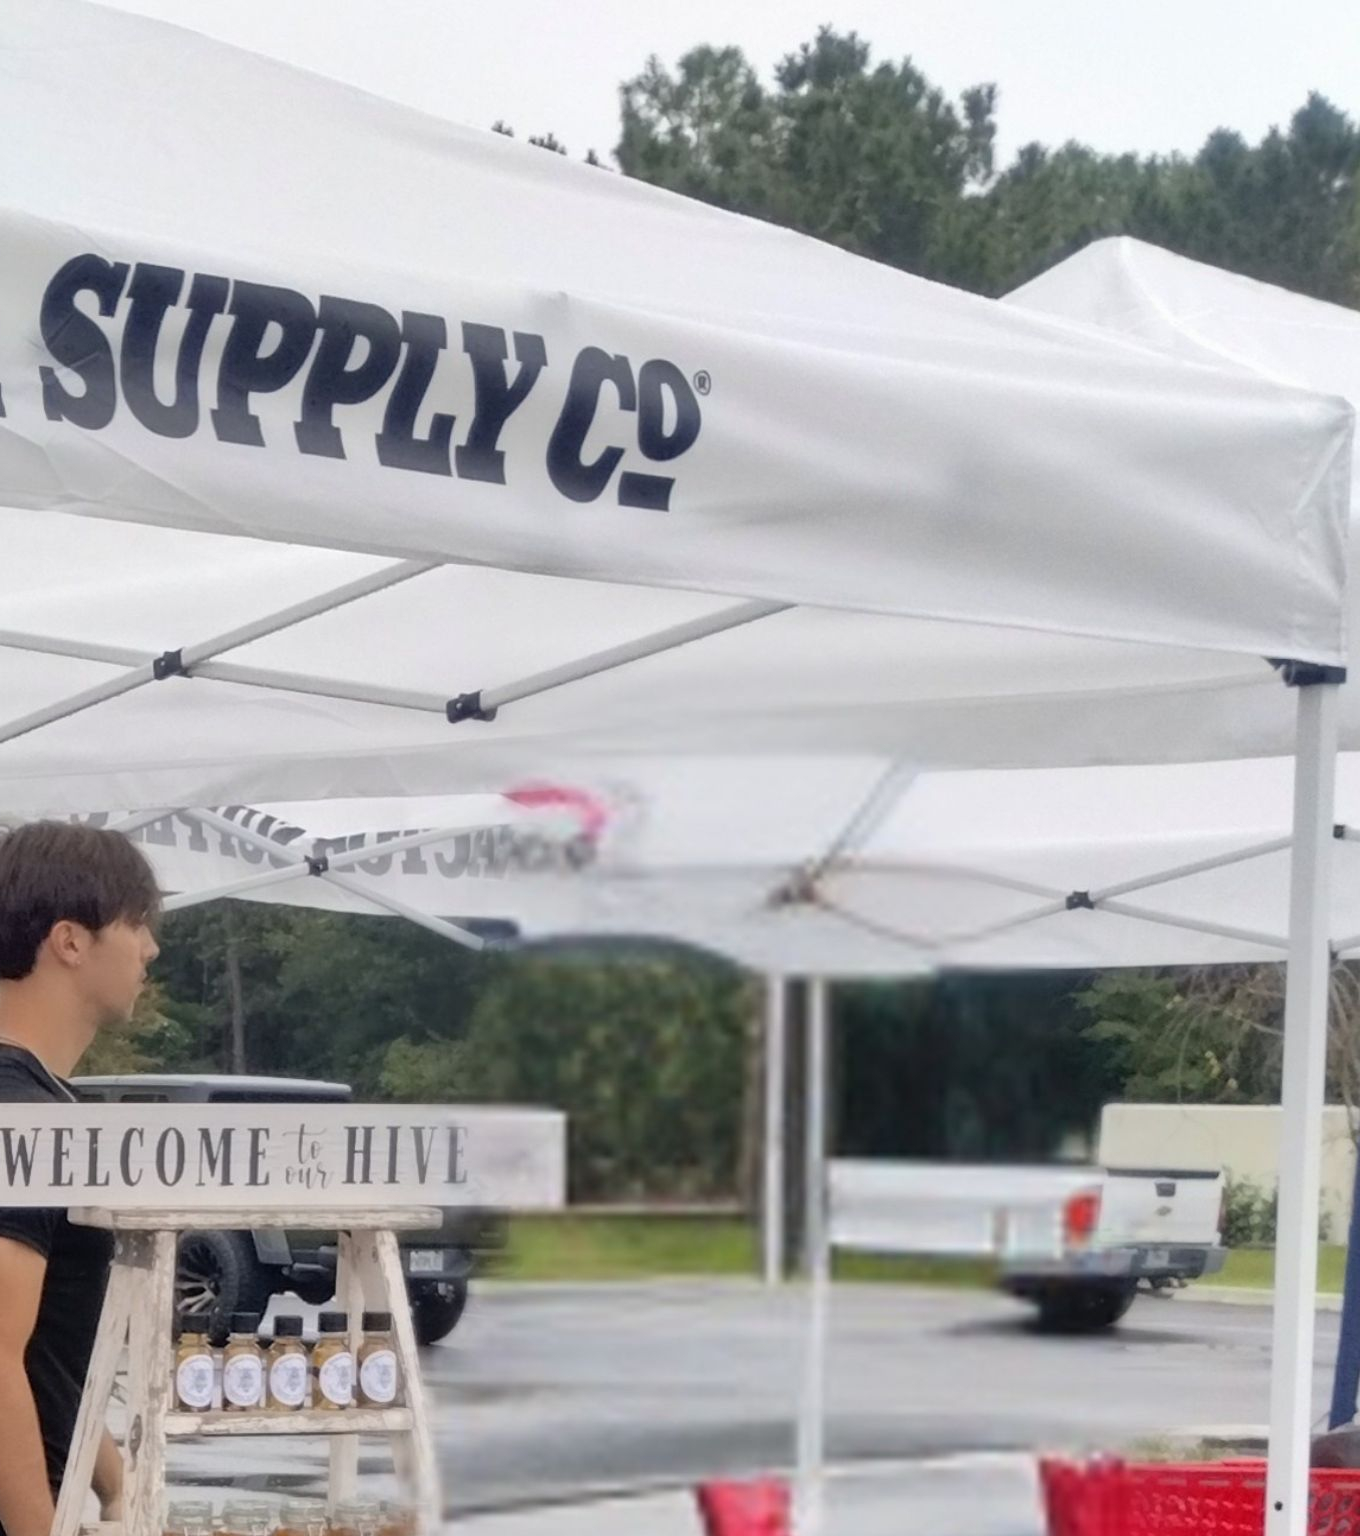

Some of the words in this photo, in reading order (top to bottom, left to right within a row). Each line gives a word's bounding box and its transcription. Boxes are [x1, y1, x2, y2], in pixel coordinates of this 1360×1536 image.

[39, 253, 547, 486] SUPPLY
[283, 1122, 327, 1165] to
[342, 1125, 470, 1185] HIVE
[284, 1162, 334, 1190] our
